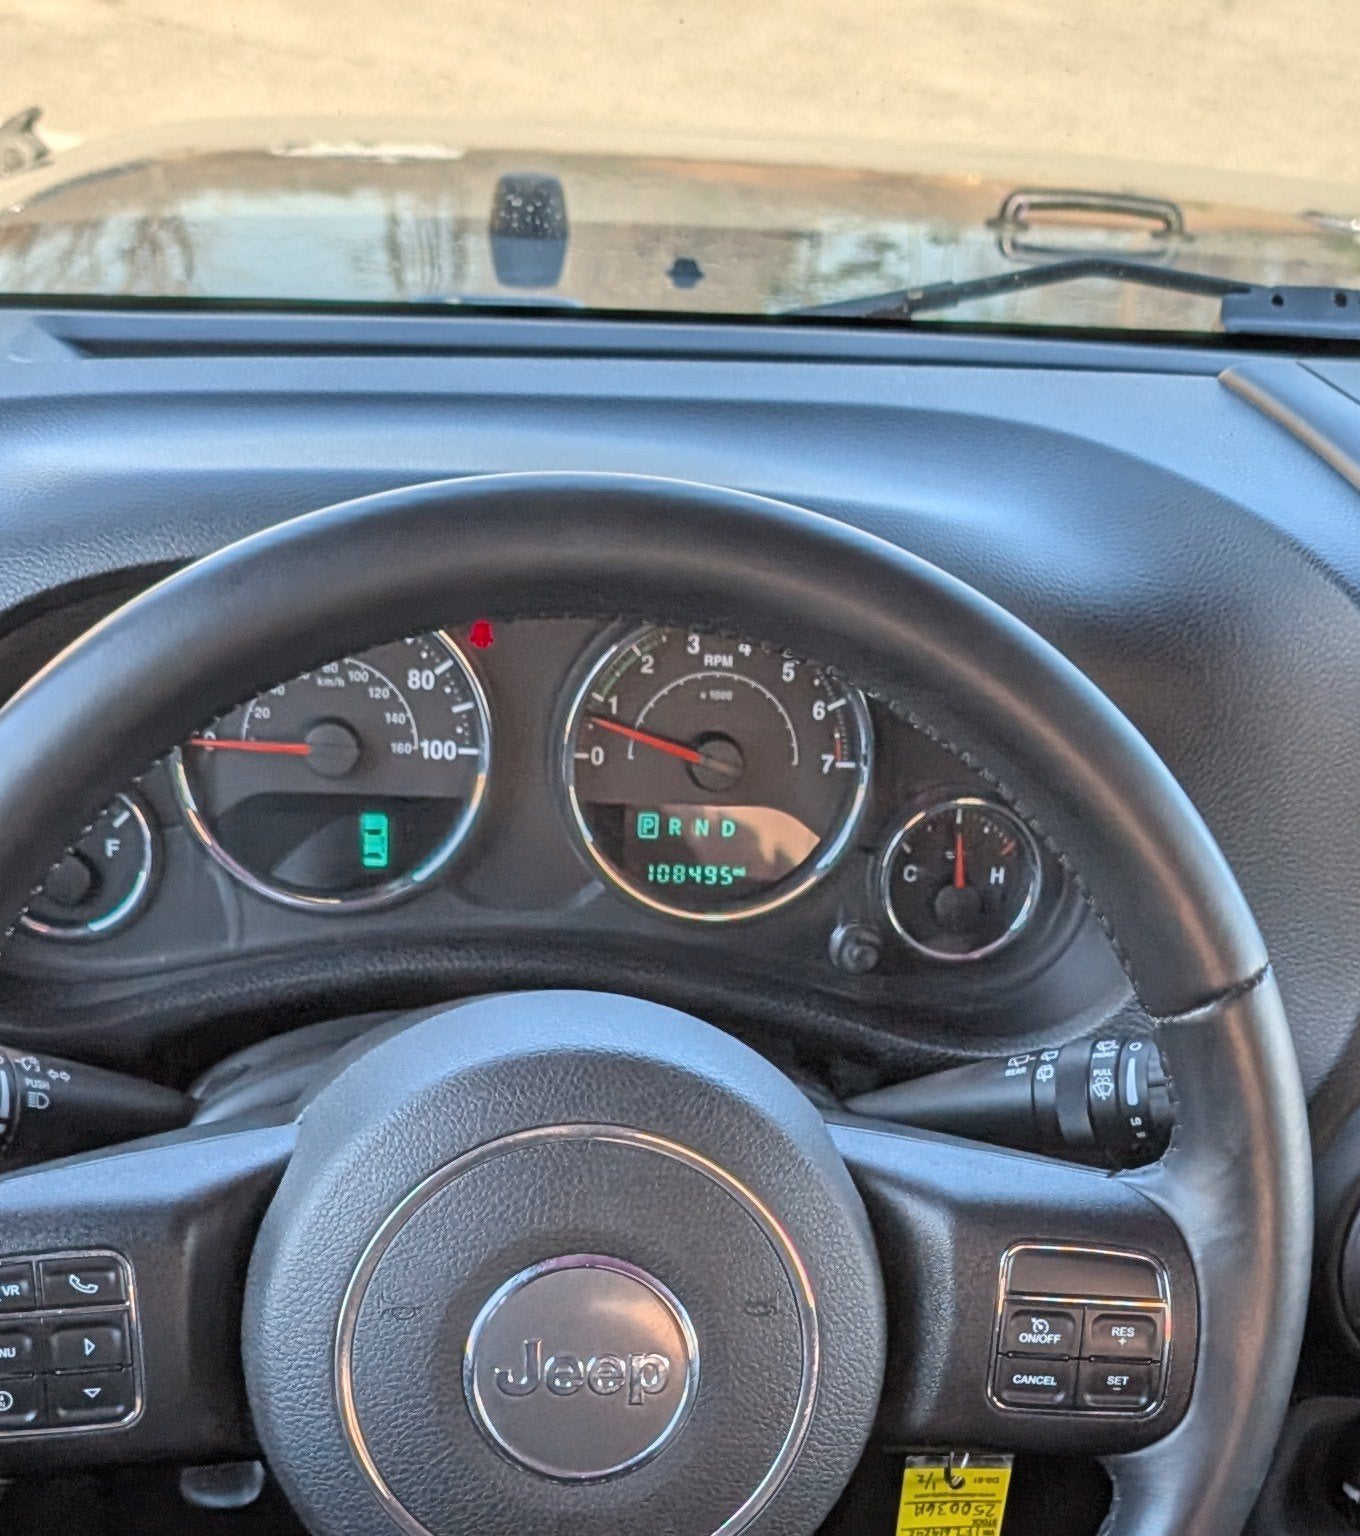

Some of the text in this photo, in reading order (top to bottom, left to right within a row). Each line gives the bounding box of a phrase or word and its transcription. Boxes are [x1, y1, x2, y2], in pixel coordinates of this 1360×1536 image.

[686, 634, 700, 655] 3
[640, 654, 655, 674] 2
[703, 653, 734, 667] RPM
[348, 670, 370, 683] 100
[406, 668, 436, 691] 80
[782, 661, 796, 682] 5
[368, 686, 390, 700] 120
[254, 706, 271, 720] 20
[385, 711, 407, 725] 140
[812, 700, 826, 721] 6
[420, 739, 457, 761] 100
[589, 747, 606, 766] 0
[821, 755, 835, 773] 7
[668, 817, 682, 836] R
[695, 817, 710, 837] N
[721, 819, 736, 837] D
[104, 838, 121, 858] F
[647, 864, 733, 886] 108495
[902, 865, 919, 883] C
[989, 867, 1005, 885] H
[25, 1077, 50, 1090] PUSH
[1, 1283, 22, 1298] VR
[1018, 1332, 1062, 1345] ON/OFF
[1111, 1326, 1136, 1338] RES
[493, 1337, 672, 1407] Jeep
[1012, 1374, 1058, 1387] CANCEL
[1106, 1375, 1130, 1387] SET
